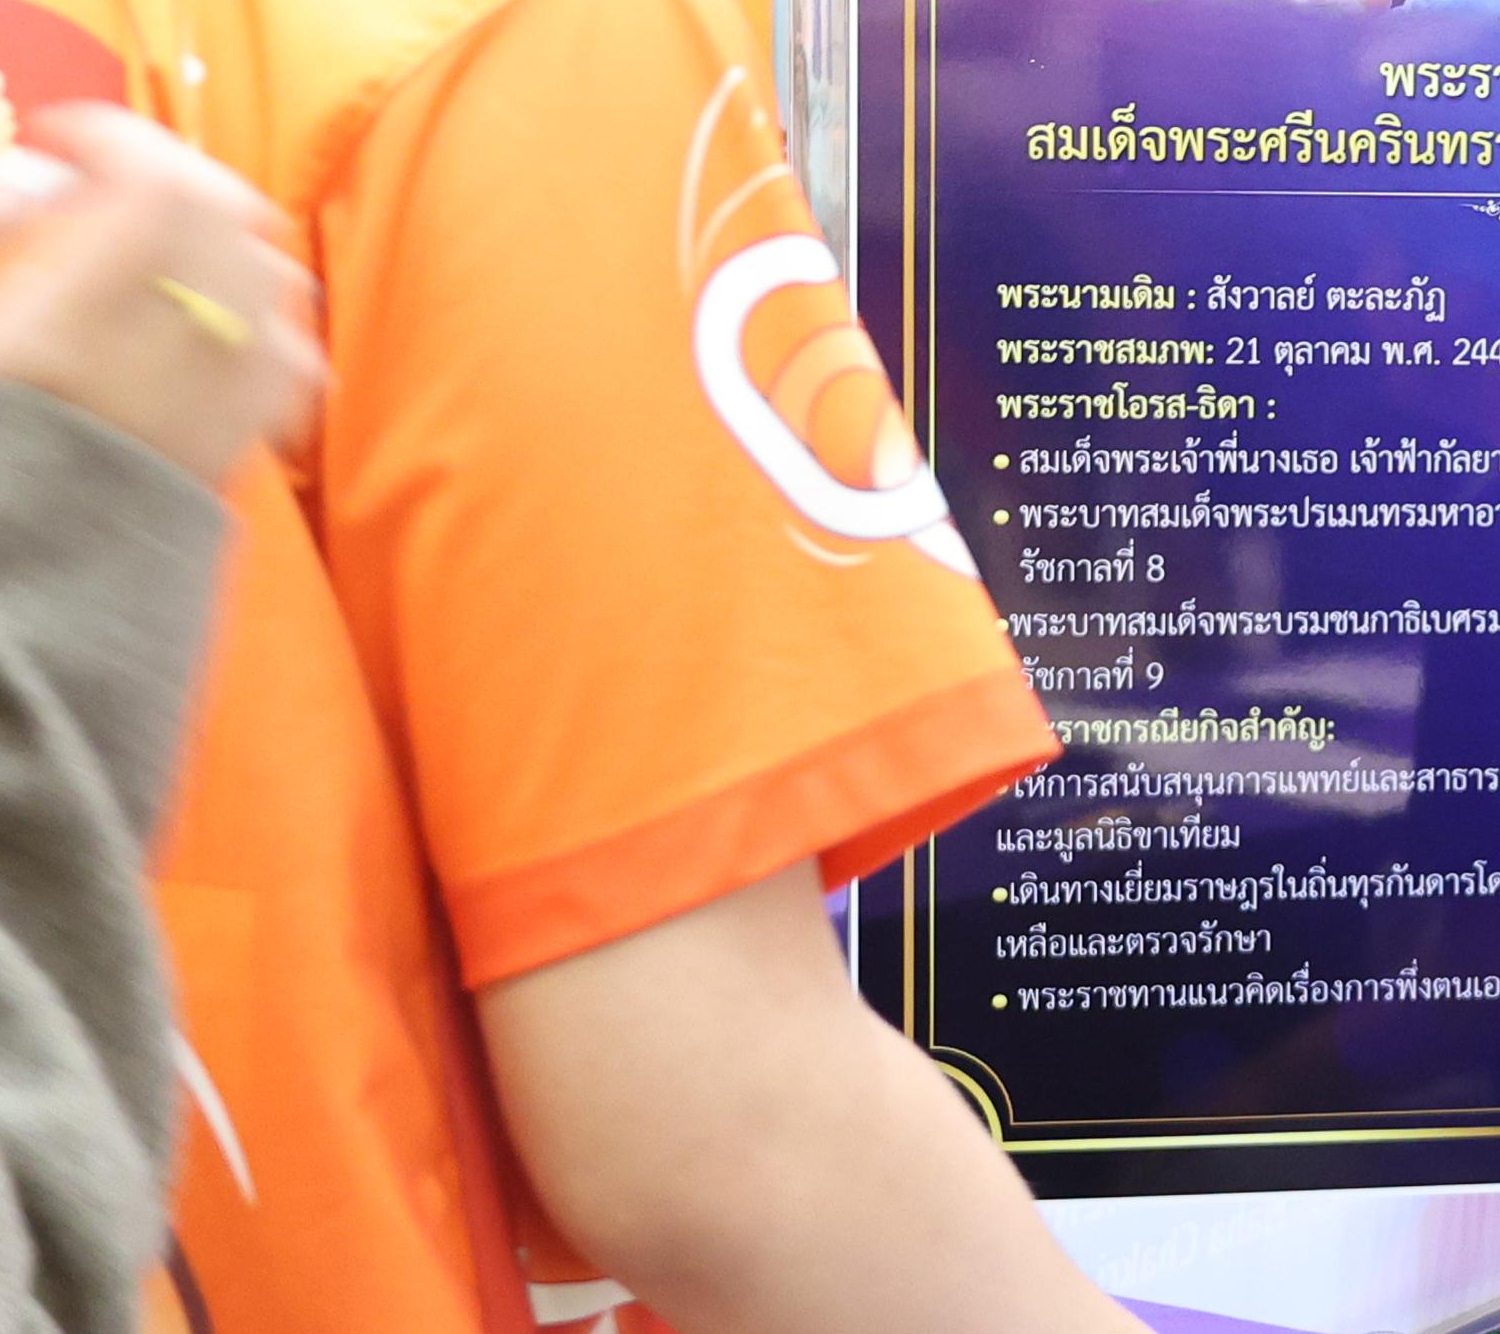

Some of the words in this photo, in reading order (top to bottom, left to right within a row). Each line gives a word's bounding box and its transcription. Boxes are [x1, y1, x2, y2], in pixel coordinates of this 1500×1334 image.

[997, 273, 1175, 310] พระนามเดิม
[1207, 273, 1317, 311] สังวาลย์
[1326, 275, 1445, 323] ตะละภัฏ
[996, 338, 1214, 365] พระราชสมภพ:
[1225, 336, 1261, 365] 21
[1274, 341, 1370, 377] ตุลาคม
[1381, 340, 1441, 365] พ.ศ.
[996, 381, 1255, 420] พระราชโอรส-ธิดา
[1020, 429, 1338, 474] สมเด็จพระเจ้าพี่นางเธอ
[1019, 538, 1134, 583] รัชกาลที่
[1146, 554, 1165, 582] 8
[1021, 645, 1134, 691] รัชกาลที่
[1145, 661, 1164, 690] 9
[997, 816, 1240, 862] และมูลนิธิขาเทียม
[997, 919, 1271, 958] เหลือและตรวจรักษา
